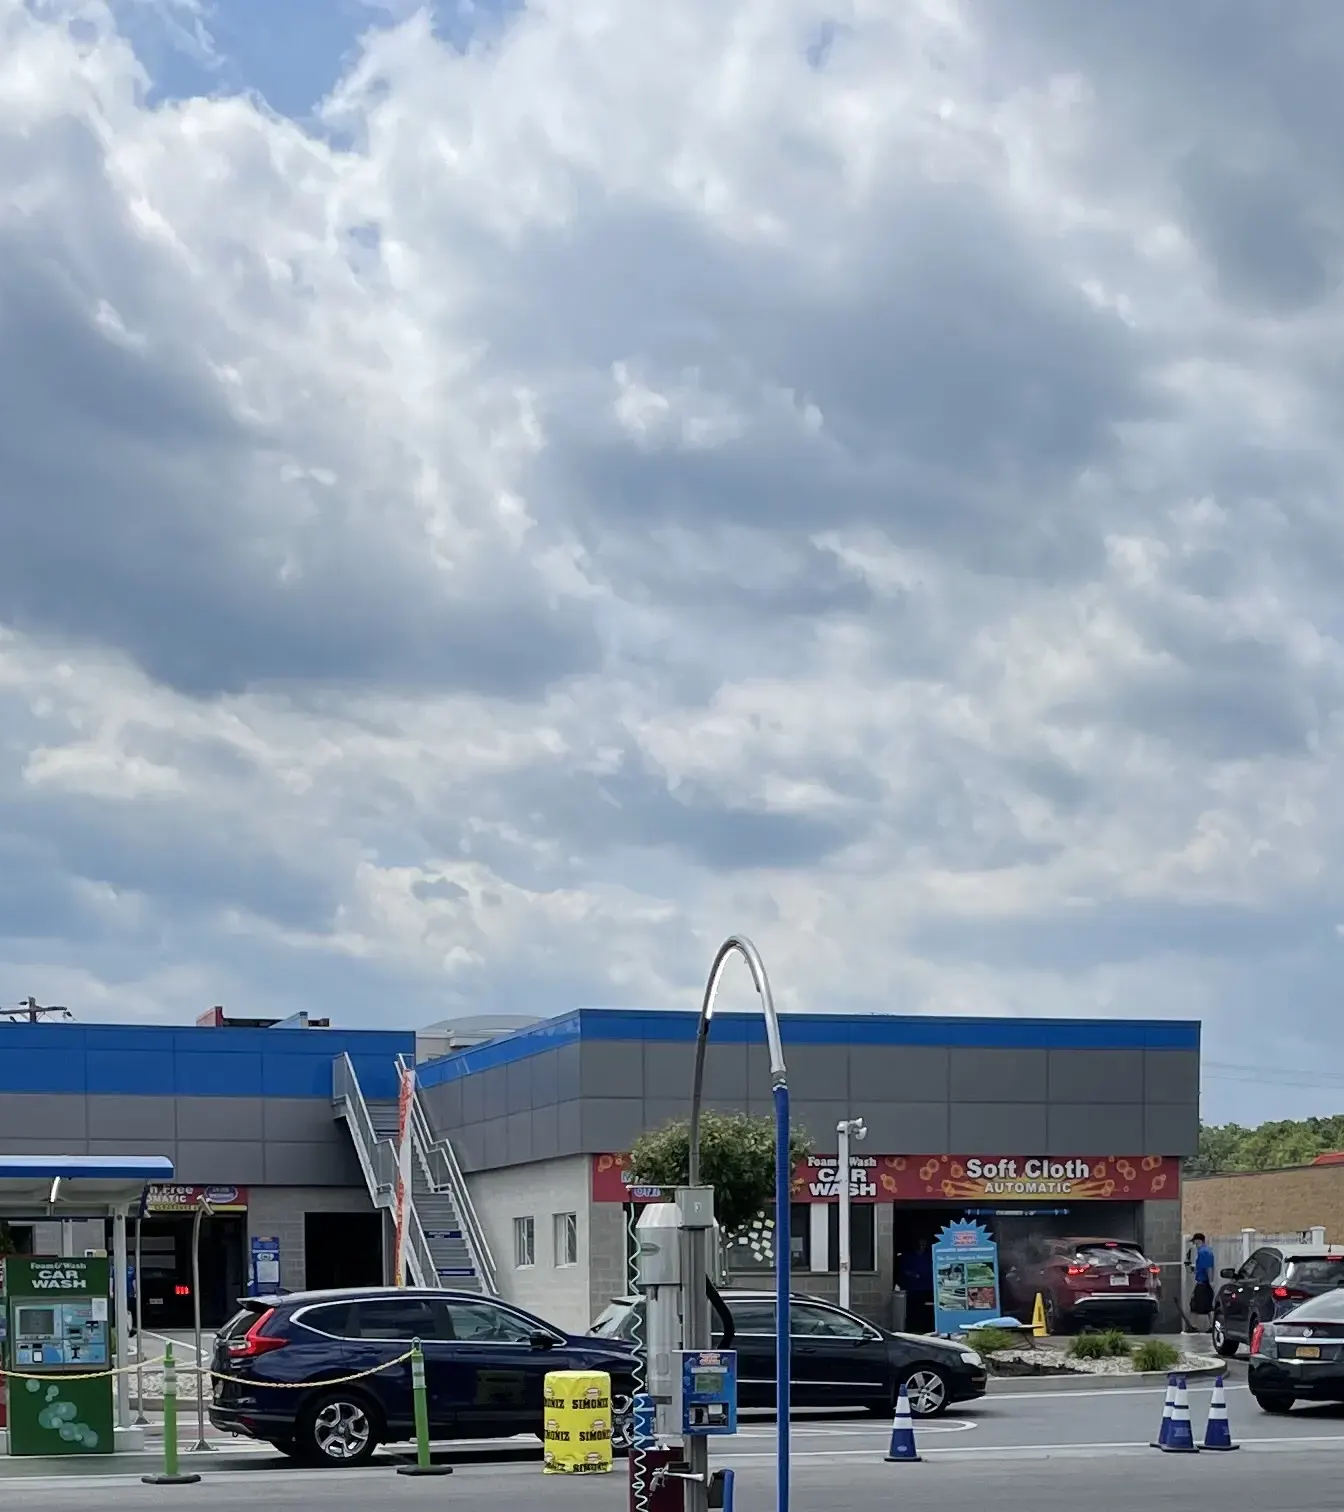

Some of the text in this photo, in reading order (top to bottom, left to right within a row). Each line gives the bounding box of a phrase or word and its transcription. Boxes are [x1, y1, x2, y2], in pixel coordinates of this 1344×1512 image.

[807, 1156, 877, 1167] Foam Wash
[966, 1158, 1089, 1179] Soft Cloth
[984, 1182, 1072, 1193] AUTOMATIC
[38, 1270, 79, 1279] CAR
[31, 1280, 87, 1289] WASH
